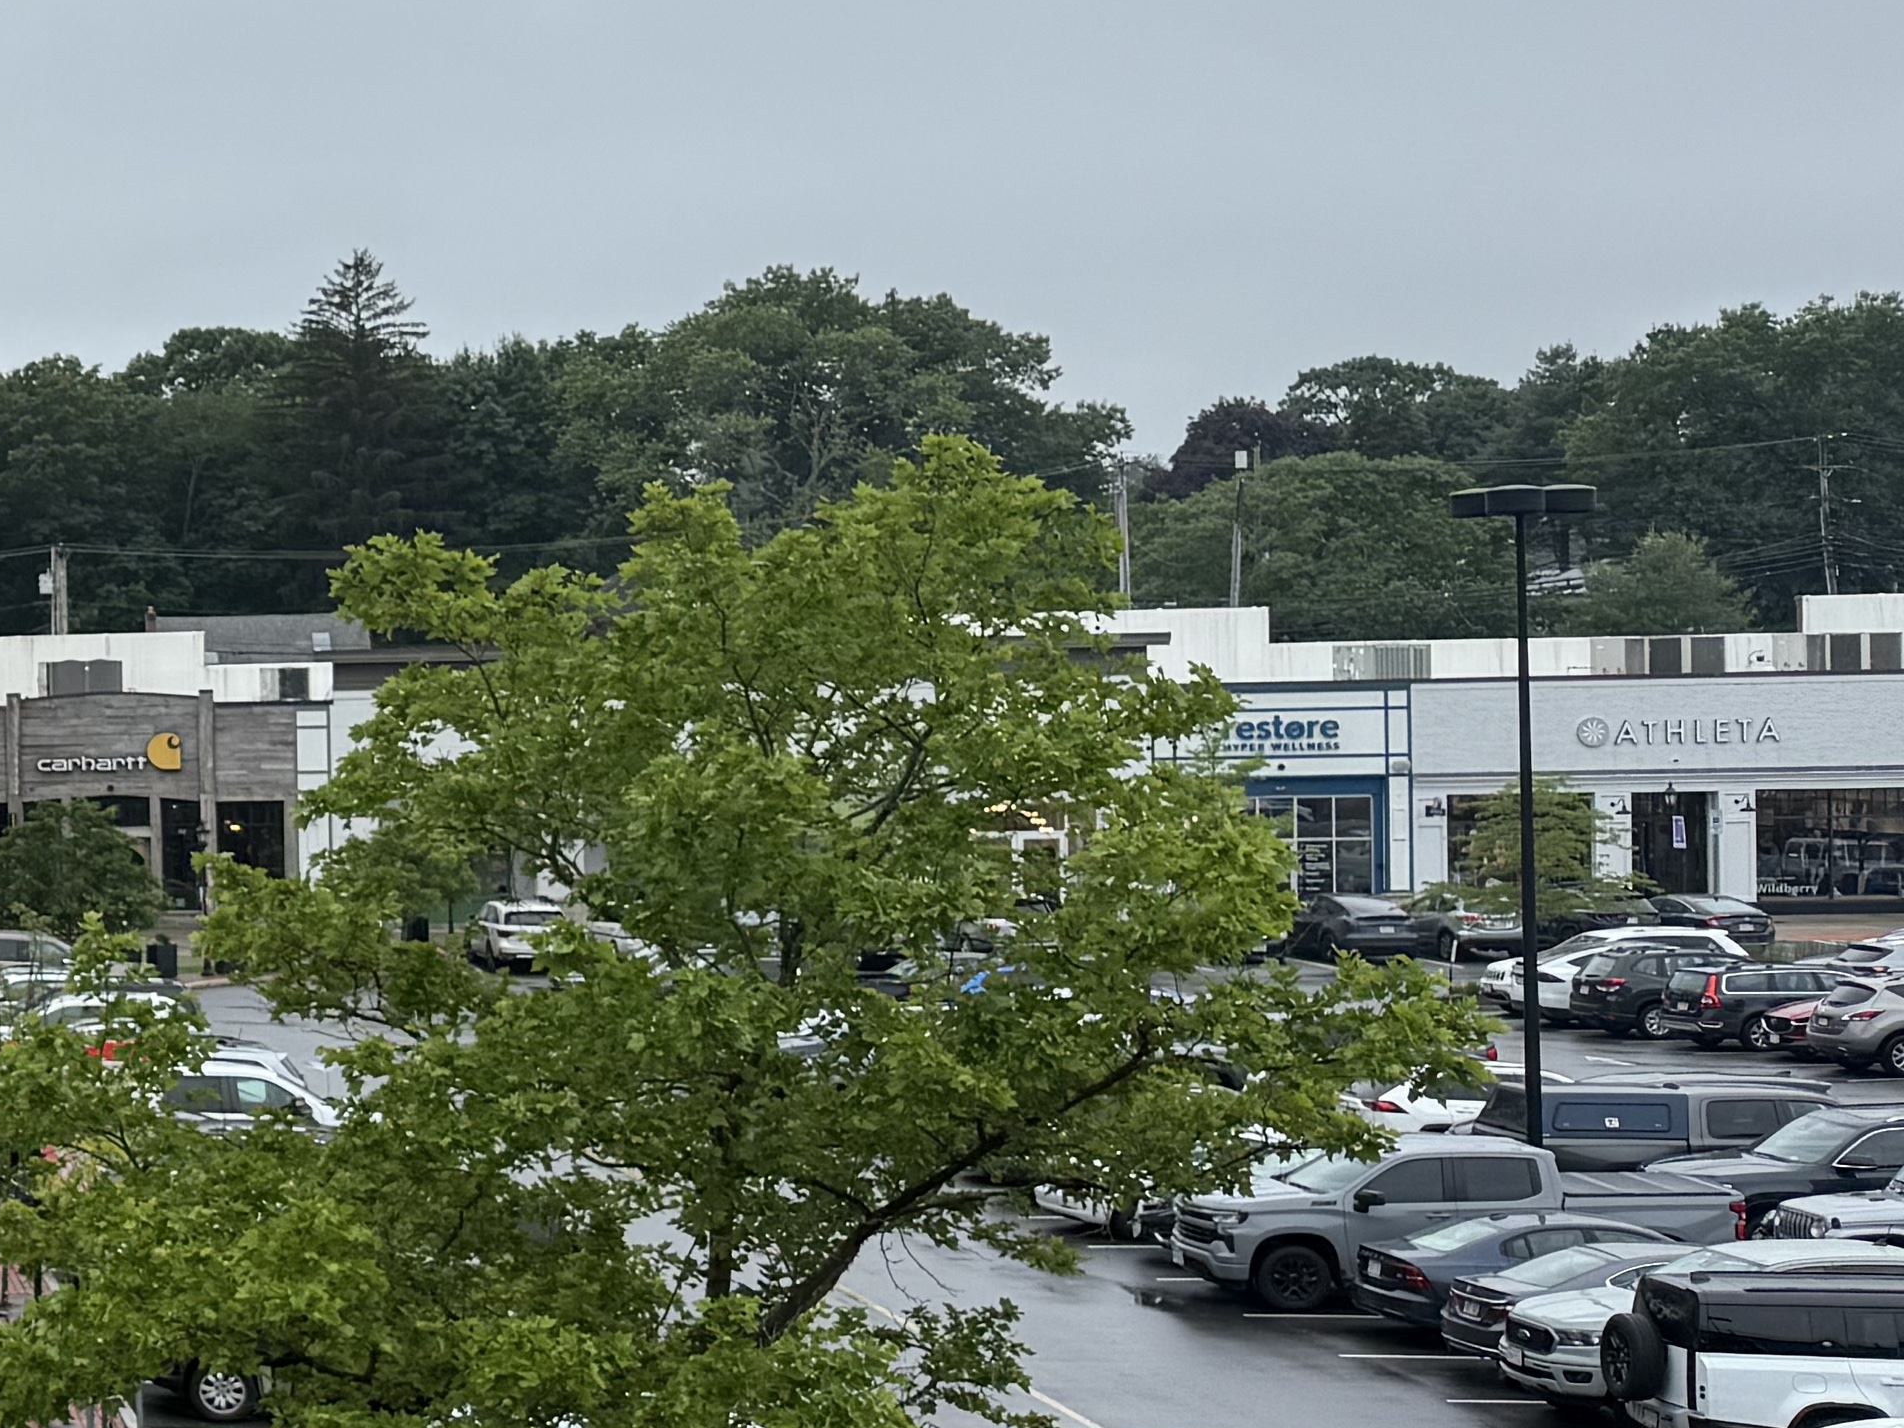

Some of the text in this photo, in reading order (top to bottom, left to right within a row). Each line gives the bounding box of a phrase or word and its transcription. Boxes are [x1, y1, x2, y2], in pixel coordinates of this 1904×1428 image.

[1616, 717, 1780, 745] ATHLETA
[1271, 741, 1340, 752] WELLNESS
[37, 756, 147, 772] carhartt
